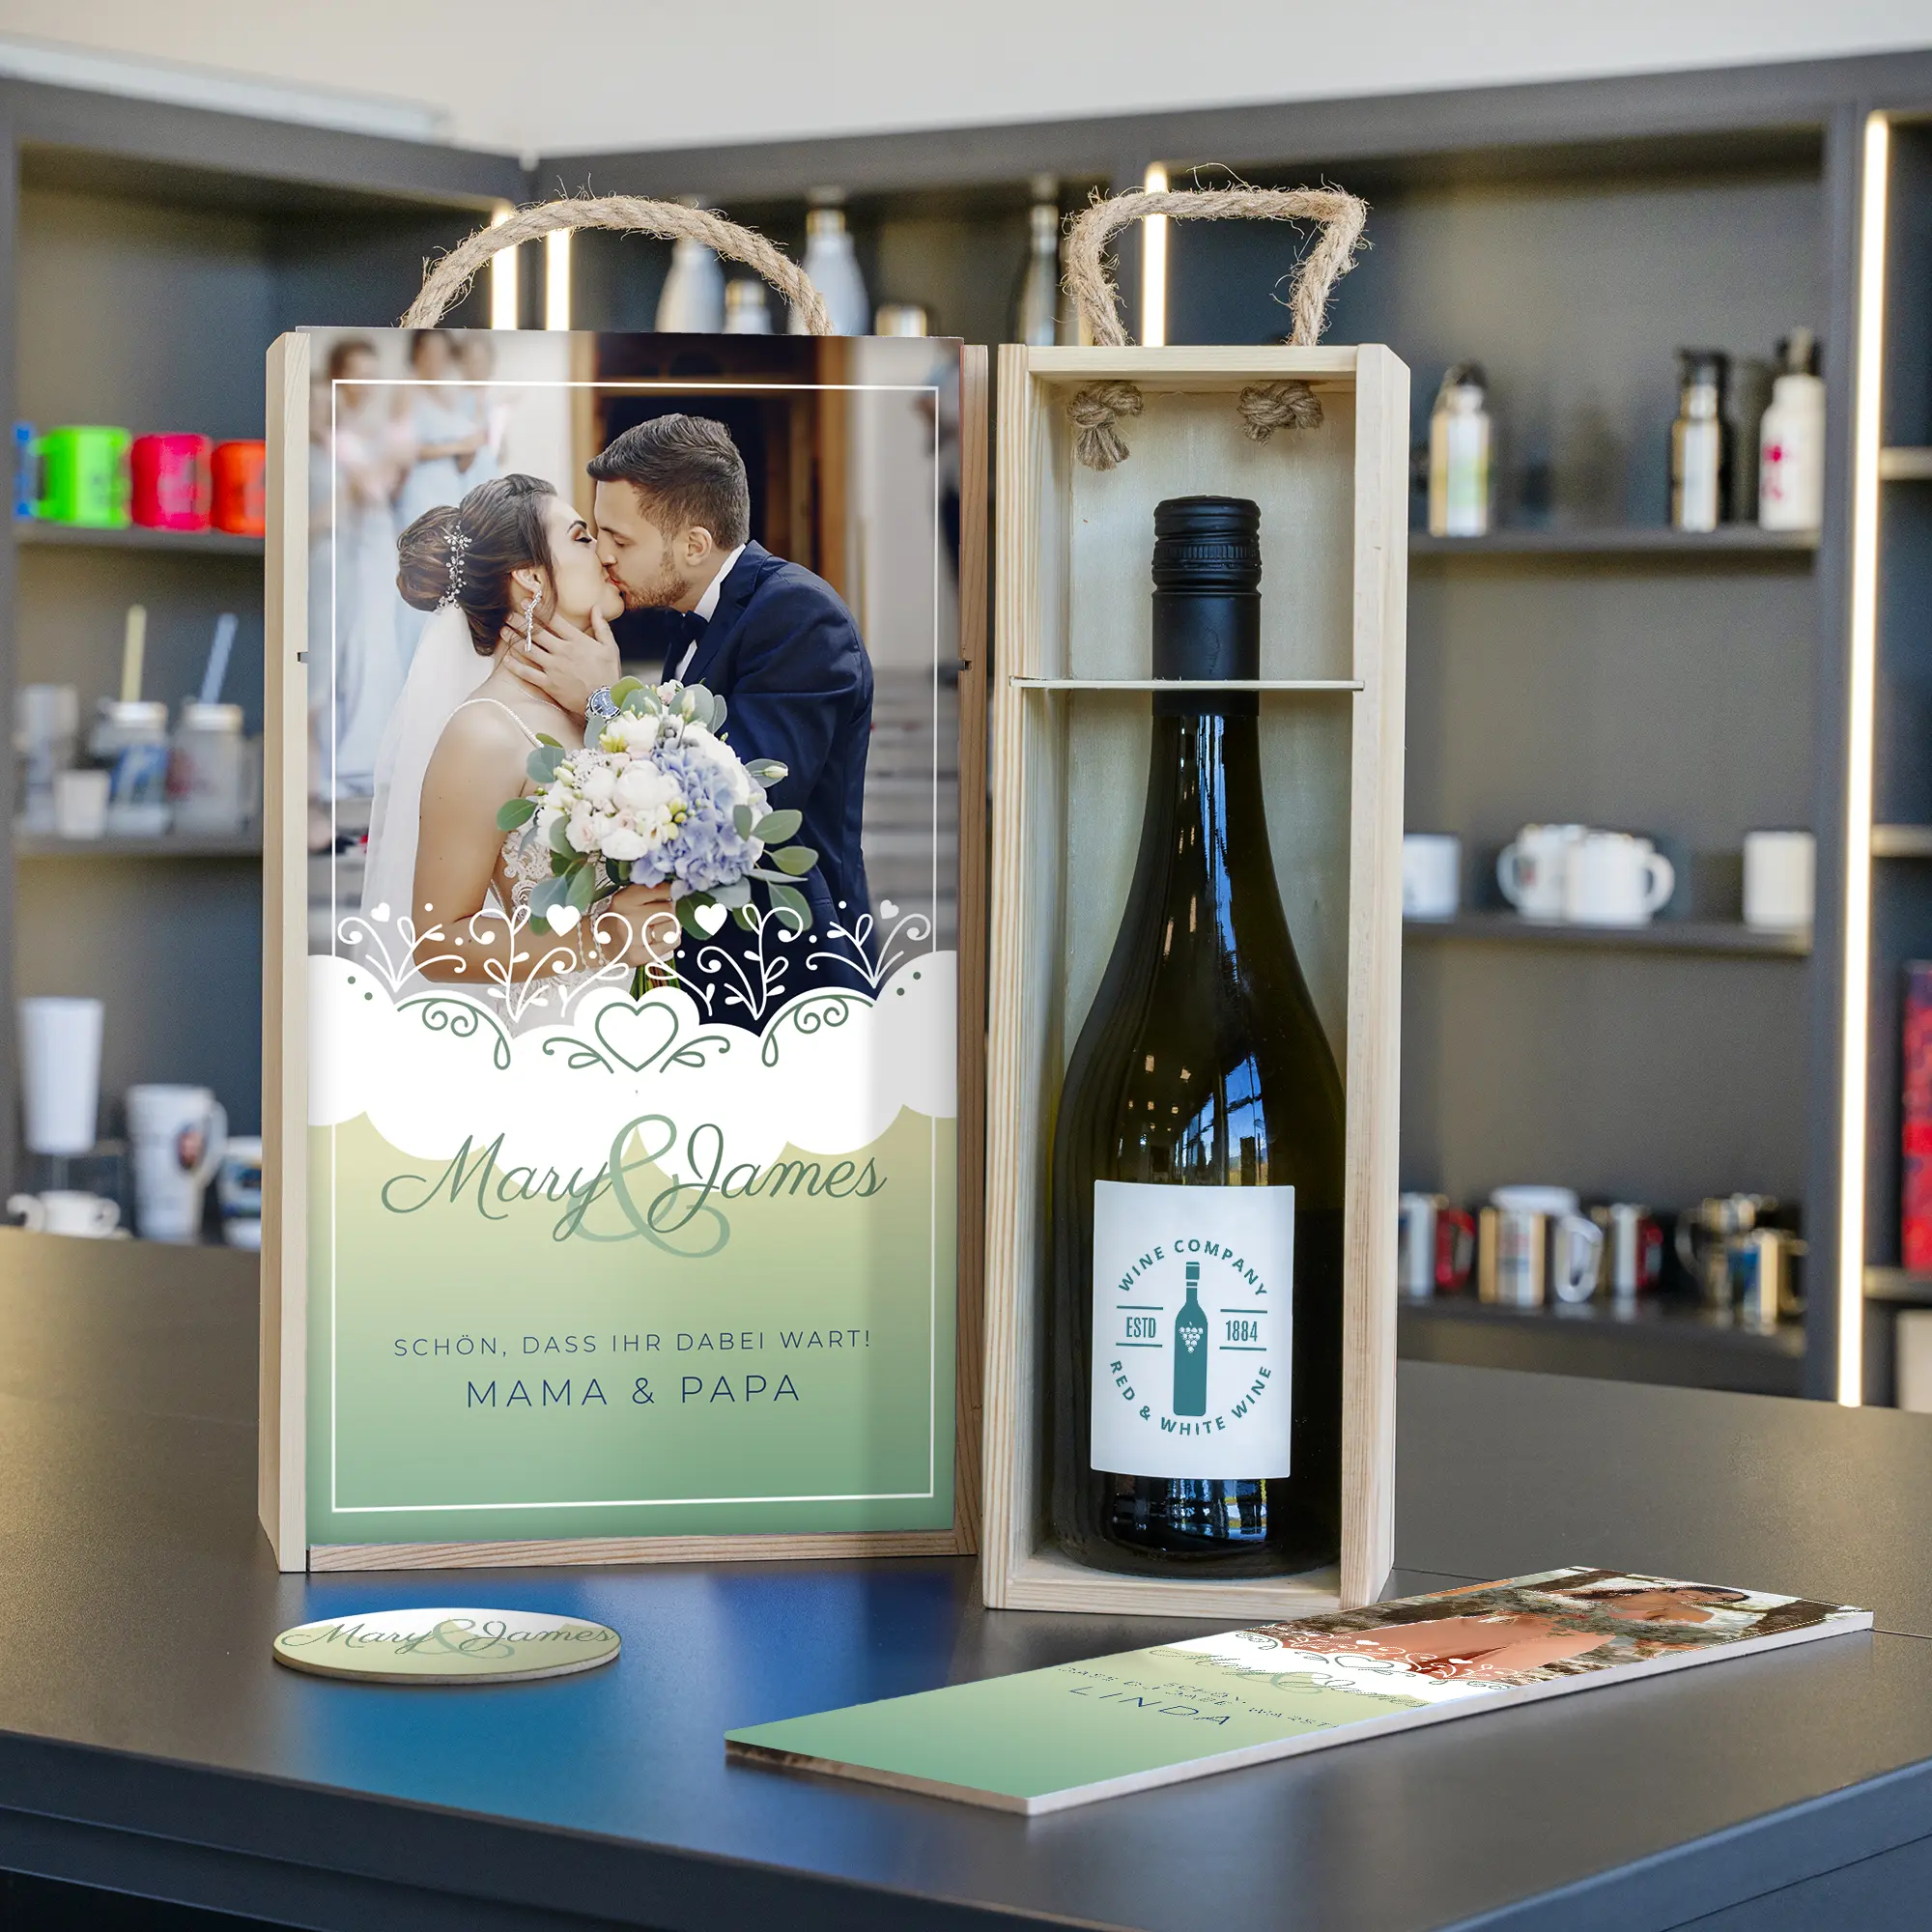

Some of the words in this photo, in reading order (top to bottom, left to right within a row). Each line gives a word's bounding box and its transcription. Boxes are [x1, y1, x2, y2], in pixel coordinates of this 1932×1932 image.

[382, 1132, 612, 1242] Mary
[566, 1114, 730, 1258] &
[647, 1123, 888, 1234] James
[1118, 1246, 1165, 1293] WINE
[1174, 1239, 1267, 1296] COMPANY
[394, 1333, 506, 1358] SCHÖN,
[523, 1334, 596, 1354] DASS
[612, 1333, 662, 1352] IHR
[676, 1331, 764, 1351] DABEI
[780, 1329, 870, 1350] WART!
[1125, 1316, 1157, 1339] ESTD
[1225, 1320, 1259, 1343] 1884
[468, 1378, 608, 1408] MAMA
[632, 1377, 656, 1405] &
[681, 1374, 800, 1404] PAPA
[1110, 1360, 1135, 1401] RED
[1139, 1405, 1151, 1421] &
[1160, 1416, 1226, 1436] WHITE
[1231, 1366, 1272, 1419] WINE
[280, 1623, 435, 1655] Mary
[405, 1618, 516, 1660] &
[459, 1620, 617, 1652] James
[1068, 1686, 1232, 1725] LINDA
